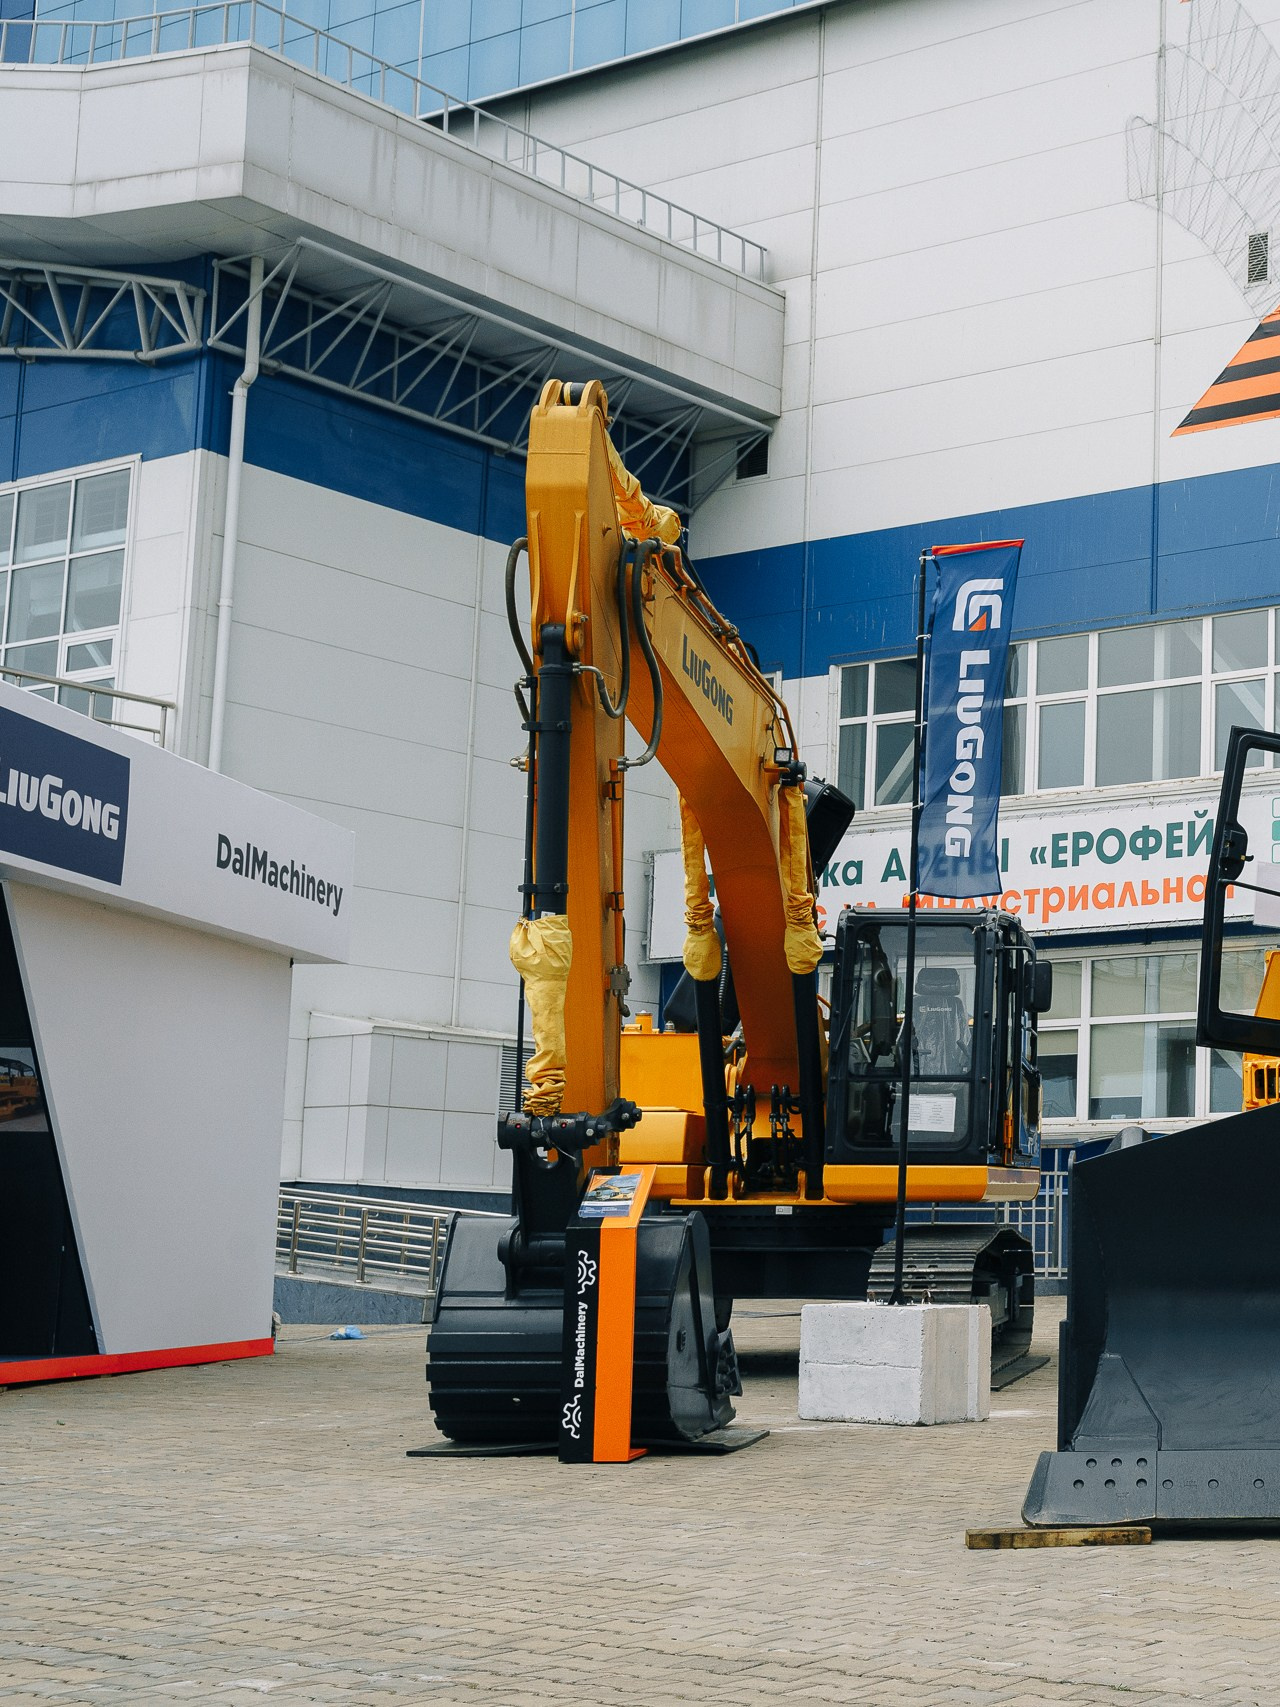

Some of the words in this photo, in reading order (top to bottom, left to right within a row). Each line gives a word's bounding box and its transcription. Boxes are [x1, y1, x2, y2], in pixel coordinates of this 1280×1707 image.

[0, 768, 120, 840] IUGONG
[216, 833, 343, 917] DalMachinery
[574, 1301, 589, 1388] DalMachinery
